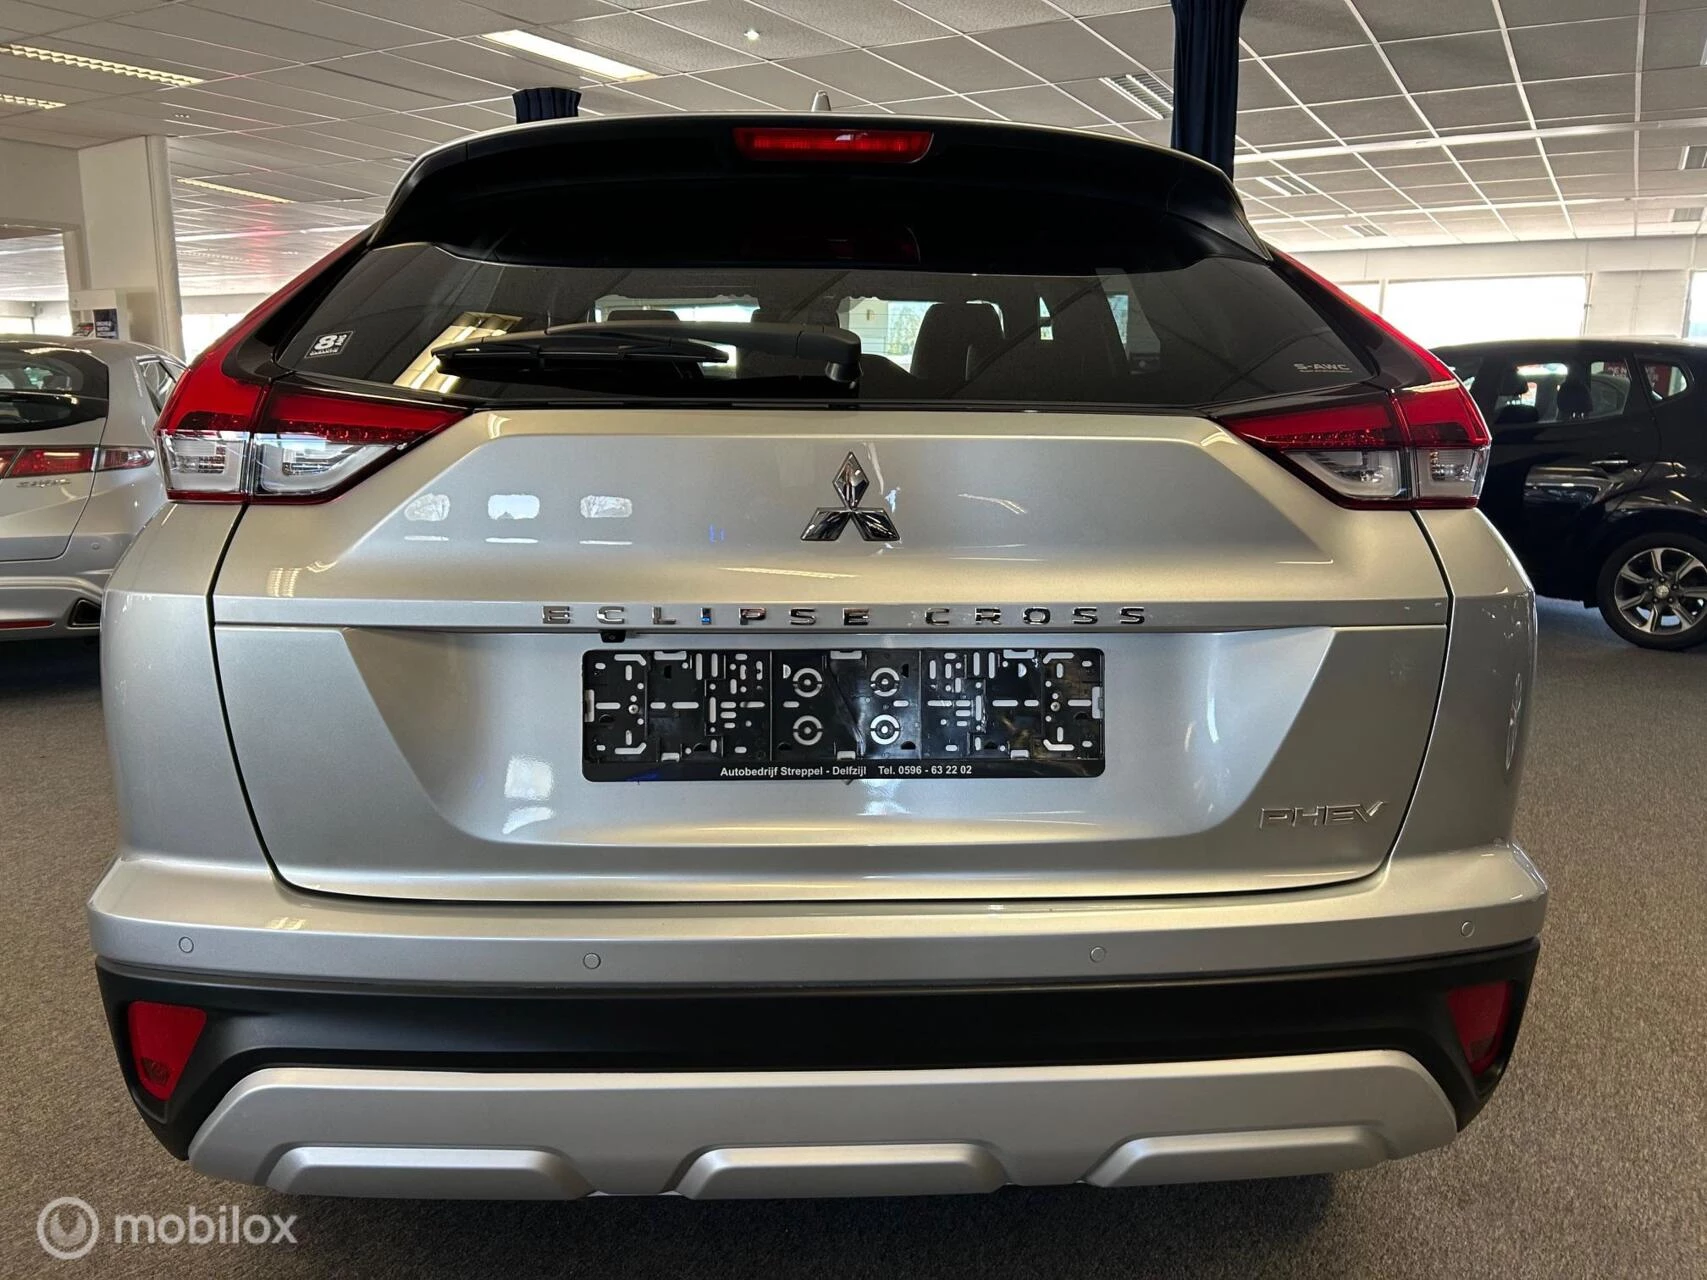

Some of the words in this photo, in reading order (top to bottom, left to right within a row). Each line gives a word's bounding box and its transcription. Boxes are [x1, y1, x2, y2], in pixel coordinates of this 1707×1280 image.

[542, 605, 870, 626] ECLIPSE
[925, 606, 1146, 626] CROSS
[720, 766, 778, 777] Autobedrijf
[780, 766, 823, 777] Streppel
[832, 766, 867, 777] Delfzijl
[878, 765, 896, 775] Tel.
[898, 765, 922, 775] 0596
[931, 765, 943, 775] 63
[945, 765, 958, 775] 22
[960, 765, 972, 775] 02
[1259, 800, 1384, 829] PHEV
